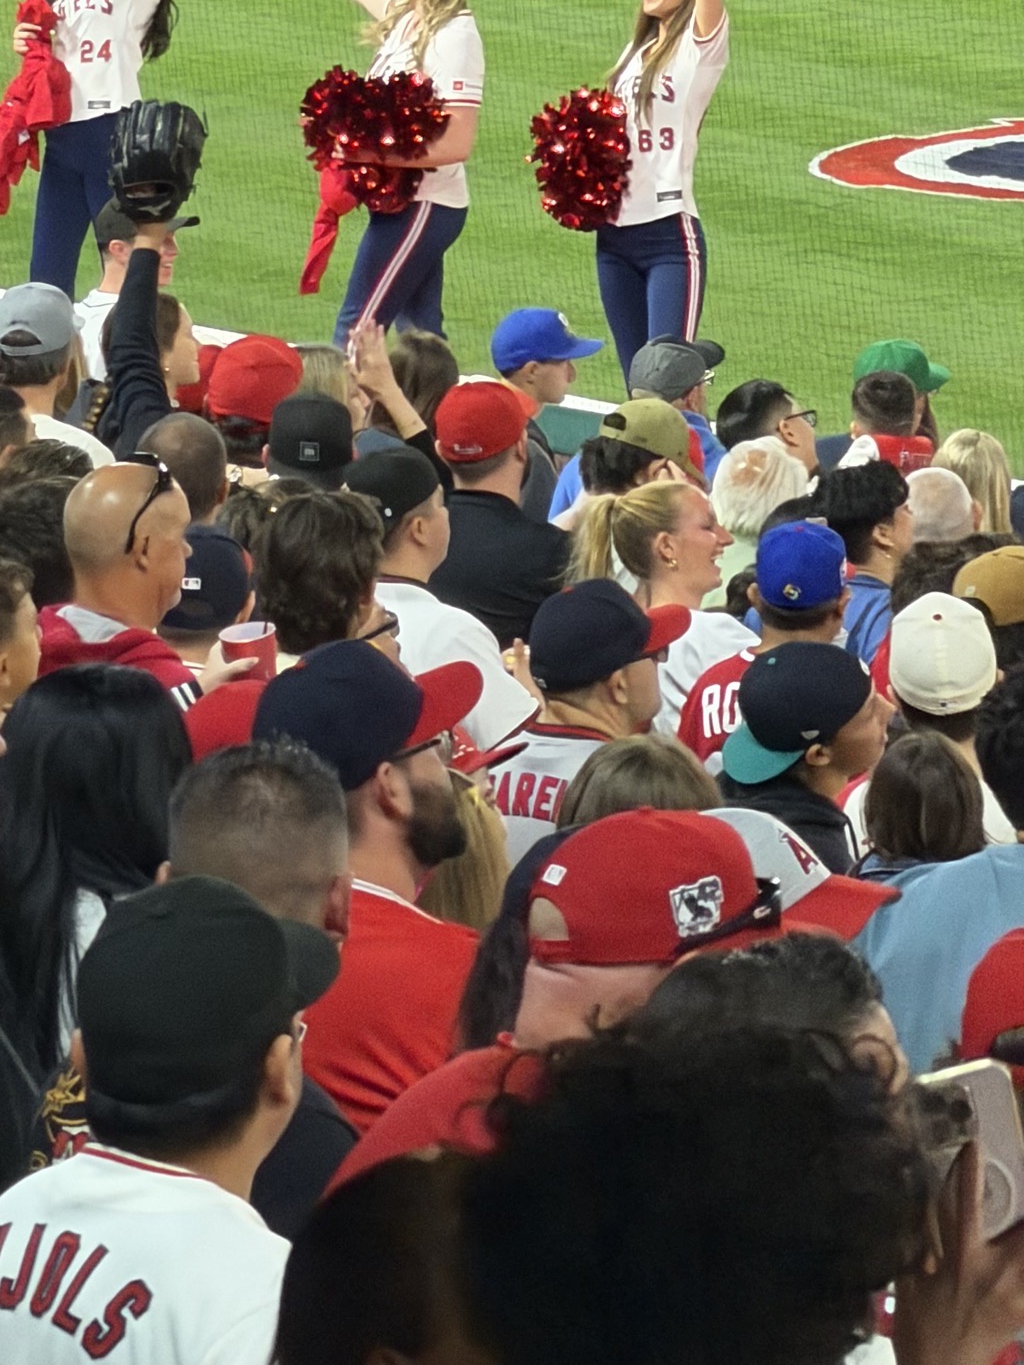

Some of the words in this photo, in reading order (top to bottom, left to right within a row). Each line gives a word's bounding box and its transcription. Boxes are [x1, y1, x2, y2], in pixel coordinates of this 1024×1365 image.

[80, 38, 112, 63] 24
[638, 127, 674, 152] 63
[701, 682, 741, 738] RO
[488, 772, 568, 822] ARE
